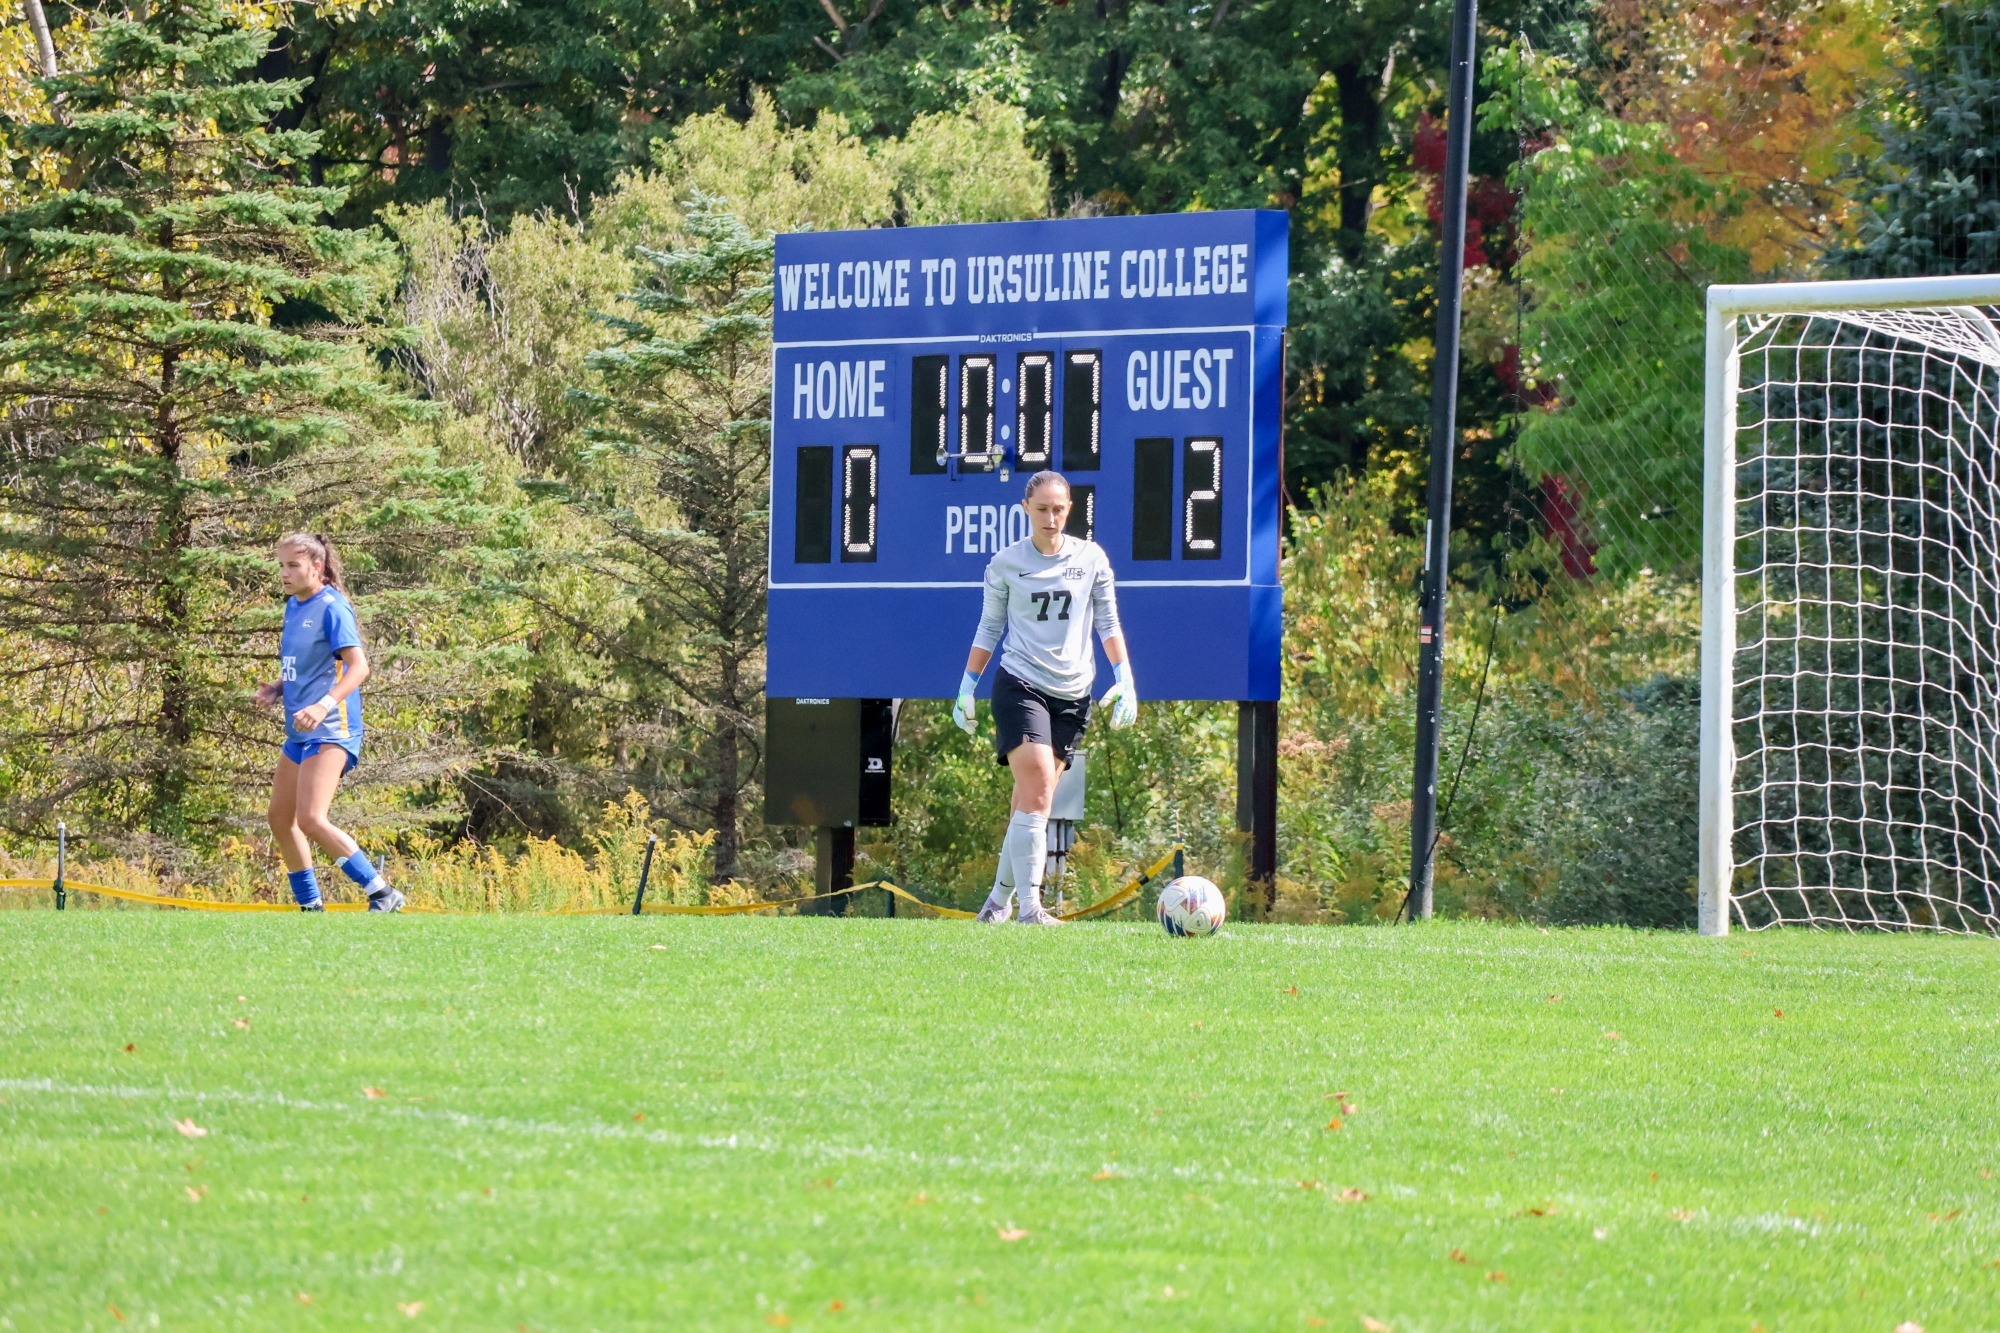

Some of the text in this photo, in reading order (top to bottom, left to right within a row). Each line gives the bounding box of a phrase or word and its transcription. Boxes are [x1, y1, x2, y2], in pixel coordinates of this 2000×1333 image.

[779, 244, 1248, 312] WELCOME TO URSULINE COLLEGE
[980, 332, 1032, 343] DAKTRONICS
[793, 360, 885, 420] HOME
[936, 353, 1100, 463] 10:07
[1127, 348, 1234, 411] GUEST
[844, 448, 876, 553] 0
[1185, 440, 1221, 549] 2
[945, 503, 1034, 554] PERIO
[1031, 590, 1072, 621] 77
